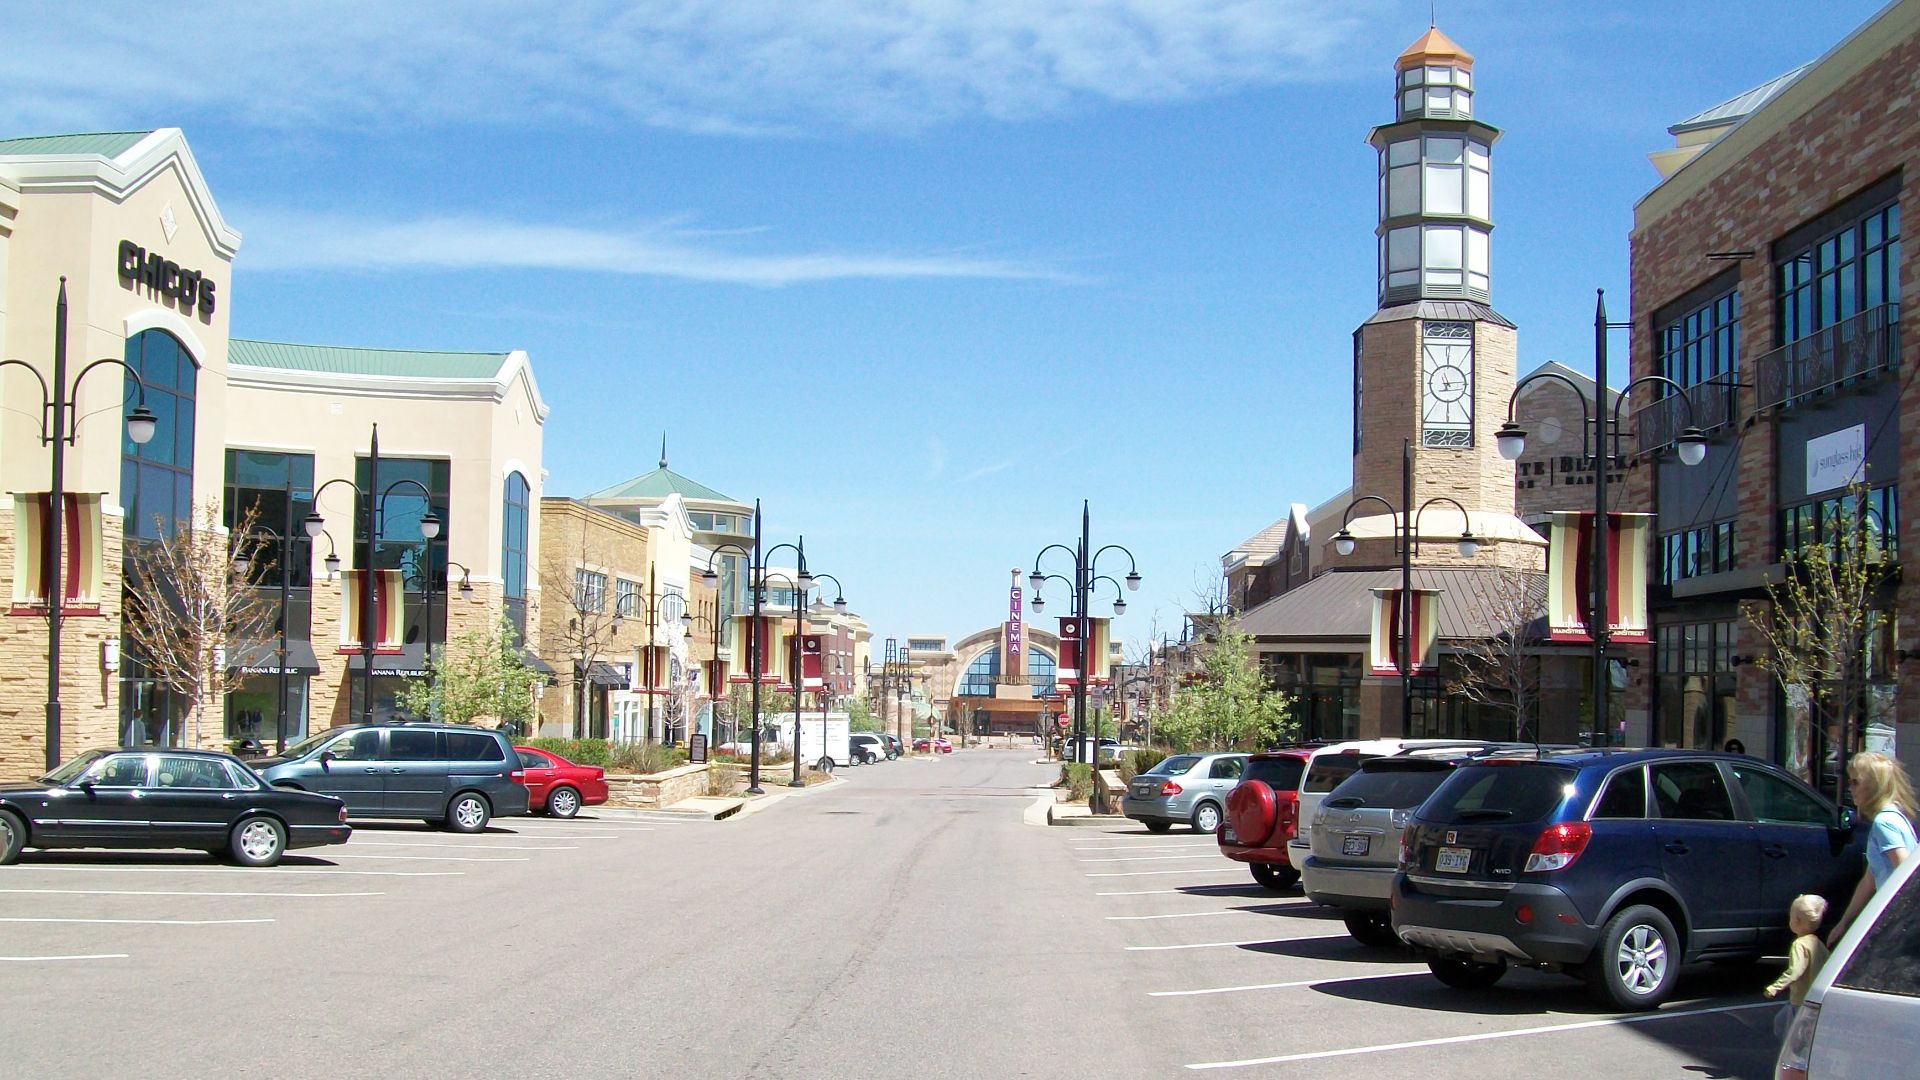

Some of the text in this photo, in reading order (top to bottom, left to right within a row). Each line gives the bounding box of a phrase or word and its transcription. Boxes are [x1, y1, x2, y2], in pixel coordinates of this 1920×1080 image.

[118, 240, 216, 314] CHICO'S
[1560, 456, 1628, 473] BLAK
[1820, 449, 1849, 472] sunglass
[1565, 473, 1624, 485] MARET
[1011, 591, 1020, 652] CINEMA
[269, 666, 298, 674] REPBLIC
